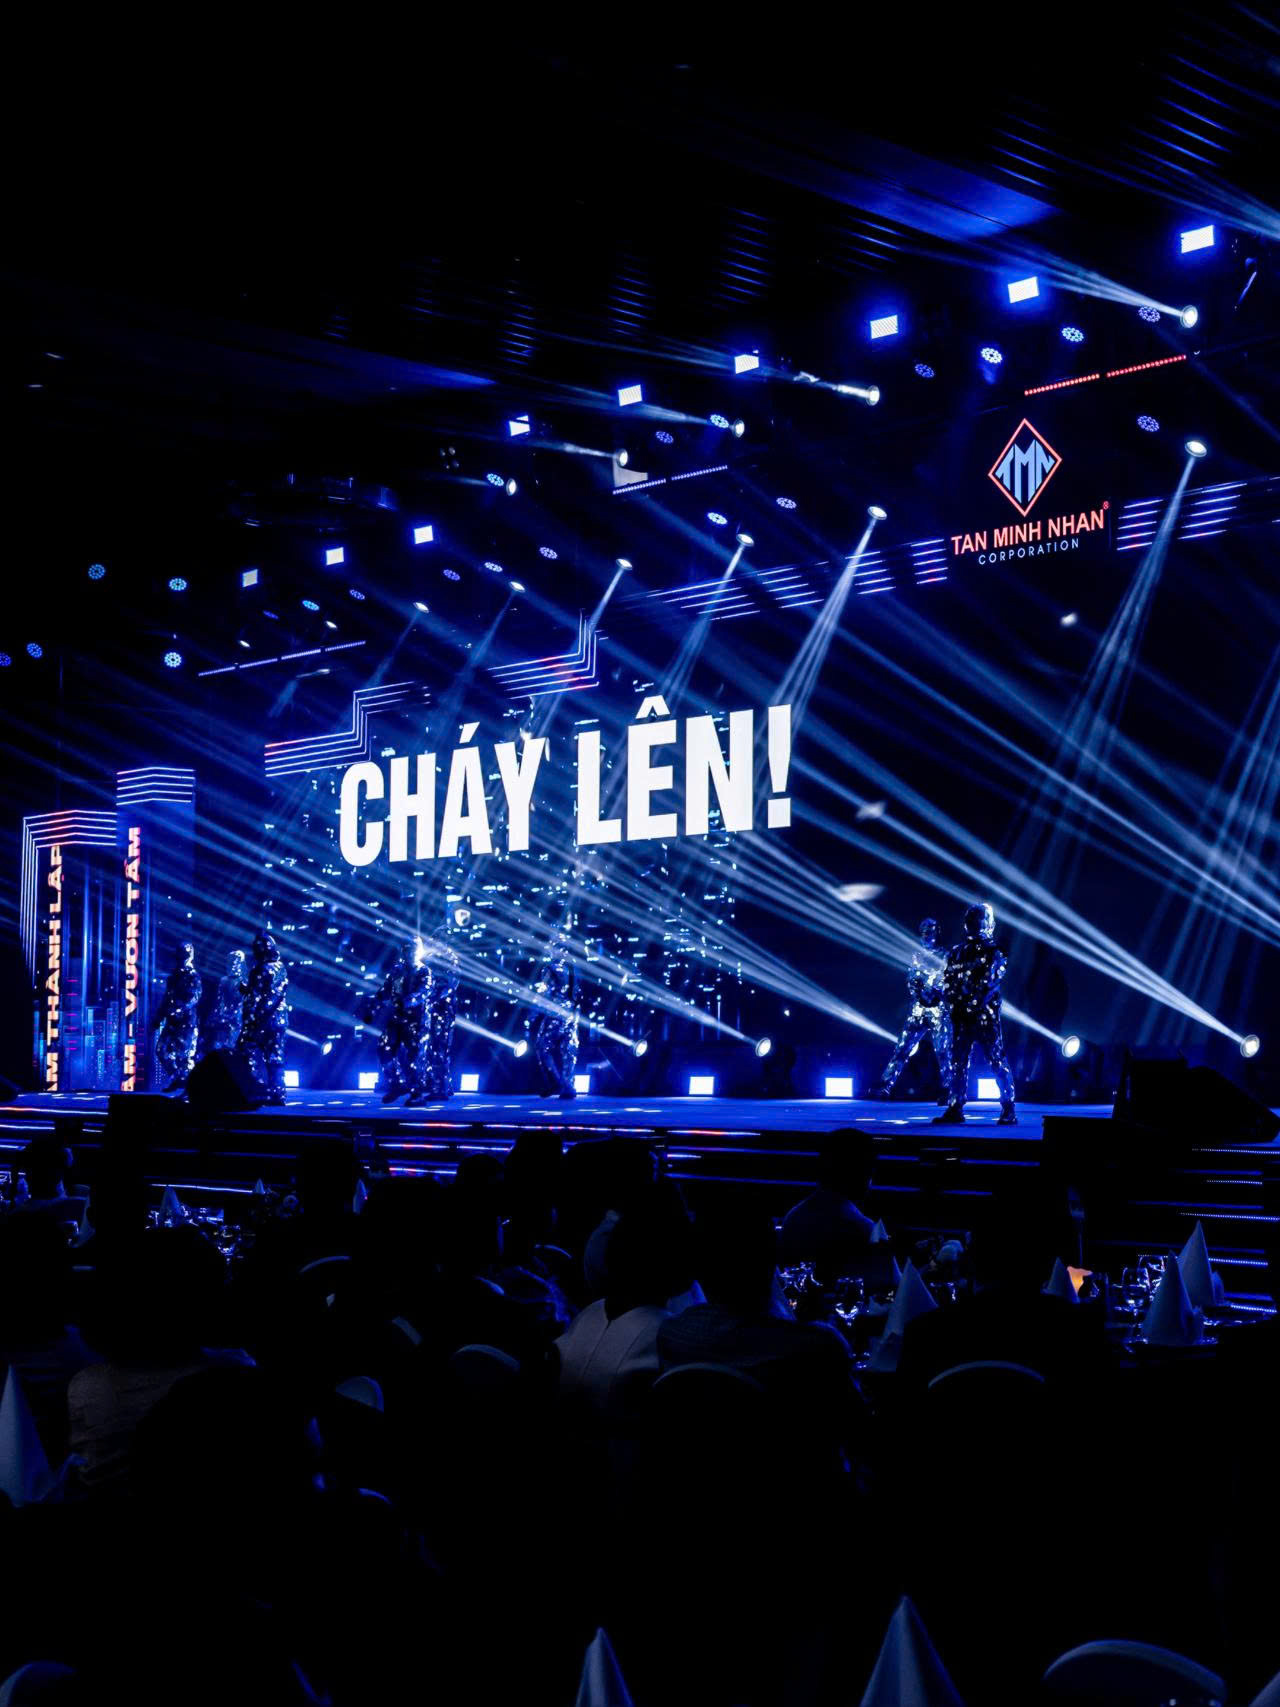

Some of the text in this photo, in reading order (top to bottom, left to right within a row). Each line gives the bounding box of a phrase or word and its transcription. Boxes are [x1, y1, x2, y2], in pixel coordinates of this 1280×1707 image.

[951, 531, 987, 555] TAN
[993, 521, 1041, 548] MINH
[978, 538, 1079, 565] CORPORATION
[339, 695, 791, 867] CHÁY LÊN!
[46, 920, 61, 1046] THÀNH
